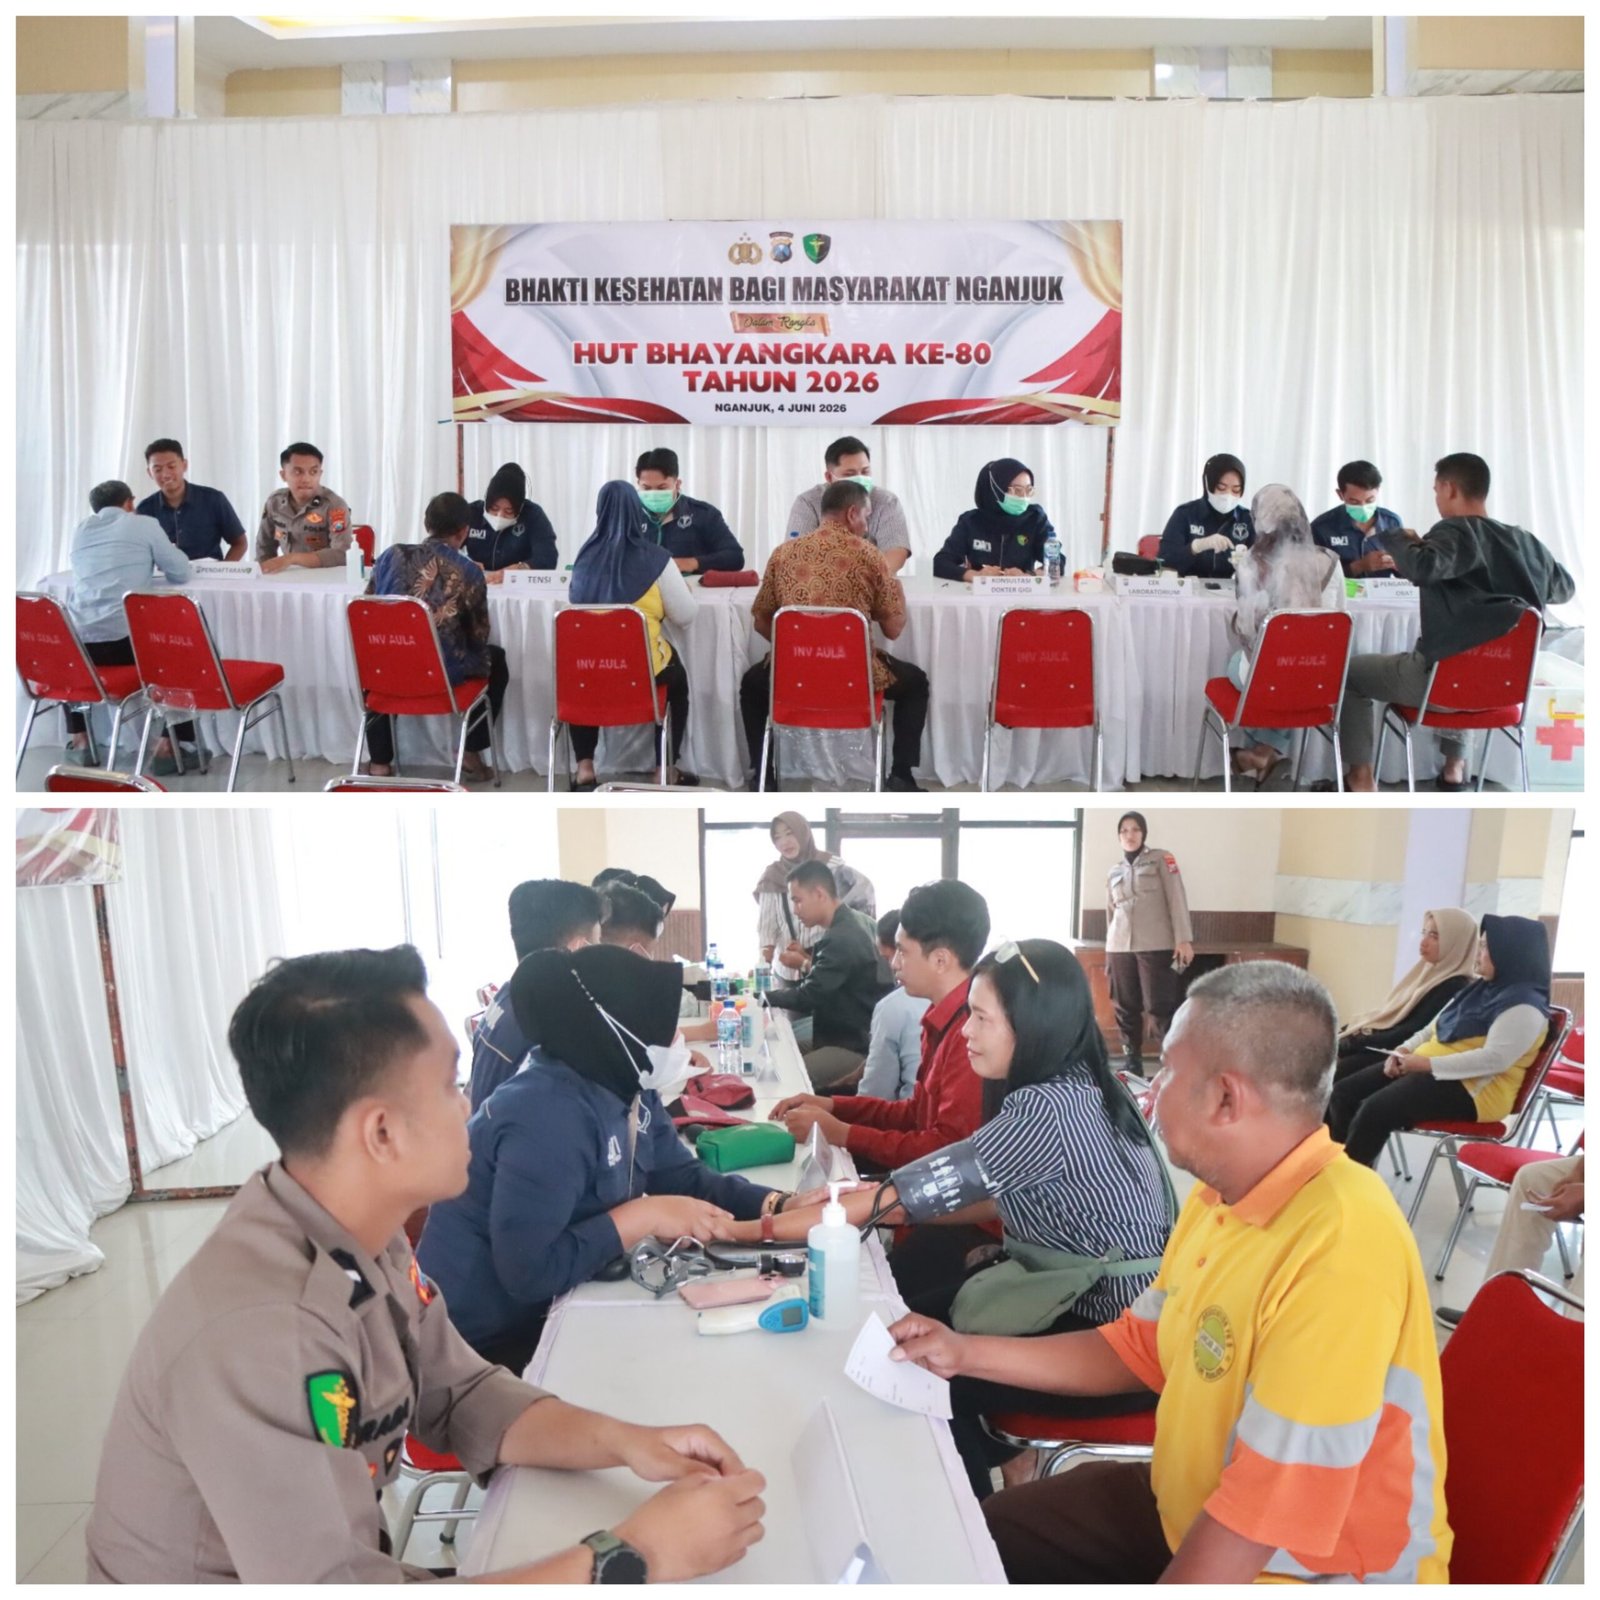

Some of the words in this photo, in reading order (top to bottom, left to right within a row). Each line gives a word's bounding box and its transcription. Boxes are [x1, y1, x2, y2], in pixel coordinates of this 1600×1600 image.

[505, 277, 589, 303] BHAKTI
[594, 276, 724, 303] KESEHATAN
[730, 276, 787, 303] BAGI
[792, 275, 951, 302] MASYARAKAT
[955, 275, 1065, 302] NGANJUK
[743, 316, 774, 328] Dalam
[777, 315, 816, 331] Rangka
[573, 342, 638, 365] HUT
[646, 342, 897, 365] BHAYANGKARA
[904, 342, 992, 365] KE-80
[682, 370, 797, 393] TAHUN
[805, 370, 880, 393] 2026
[714, 403, 775, 414] NGANJUK,
[777, 403, 785, 413] 4
[787, 403, 816, 413] JUNI
[818, 403, 847, 413] 2026
[527, 575, 552, 584] TENSI
[991, 577, 1032, 585] KONSULTASI
[1128, 588, 1181, 596] LABORATORIUM
[368, 634, 387, 645] INV
[389, 634, 416, 646] AULA
[793, 646, 813, 657] INV
[816, 647, 846, 659] AULA
[576, 658, 596, 670] INV
[598, 658, 628, 670] AULA
